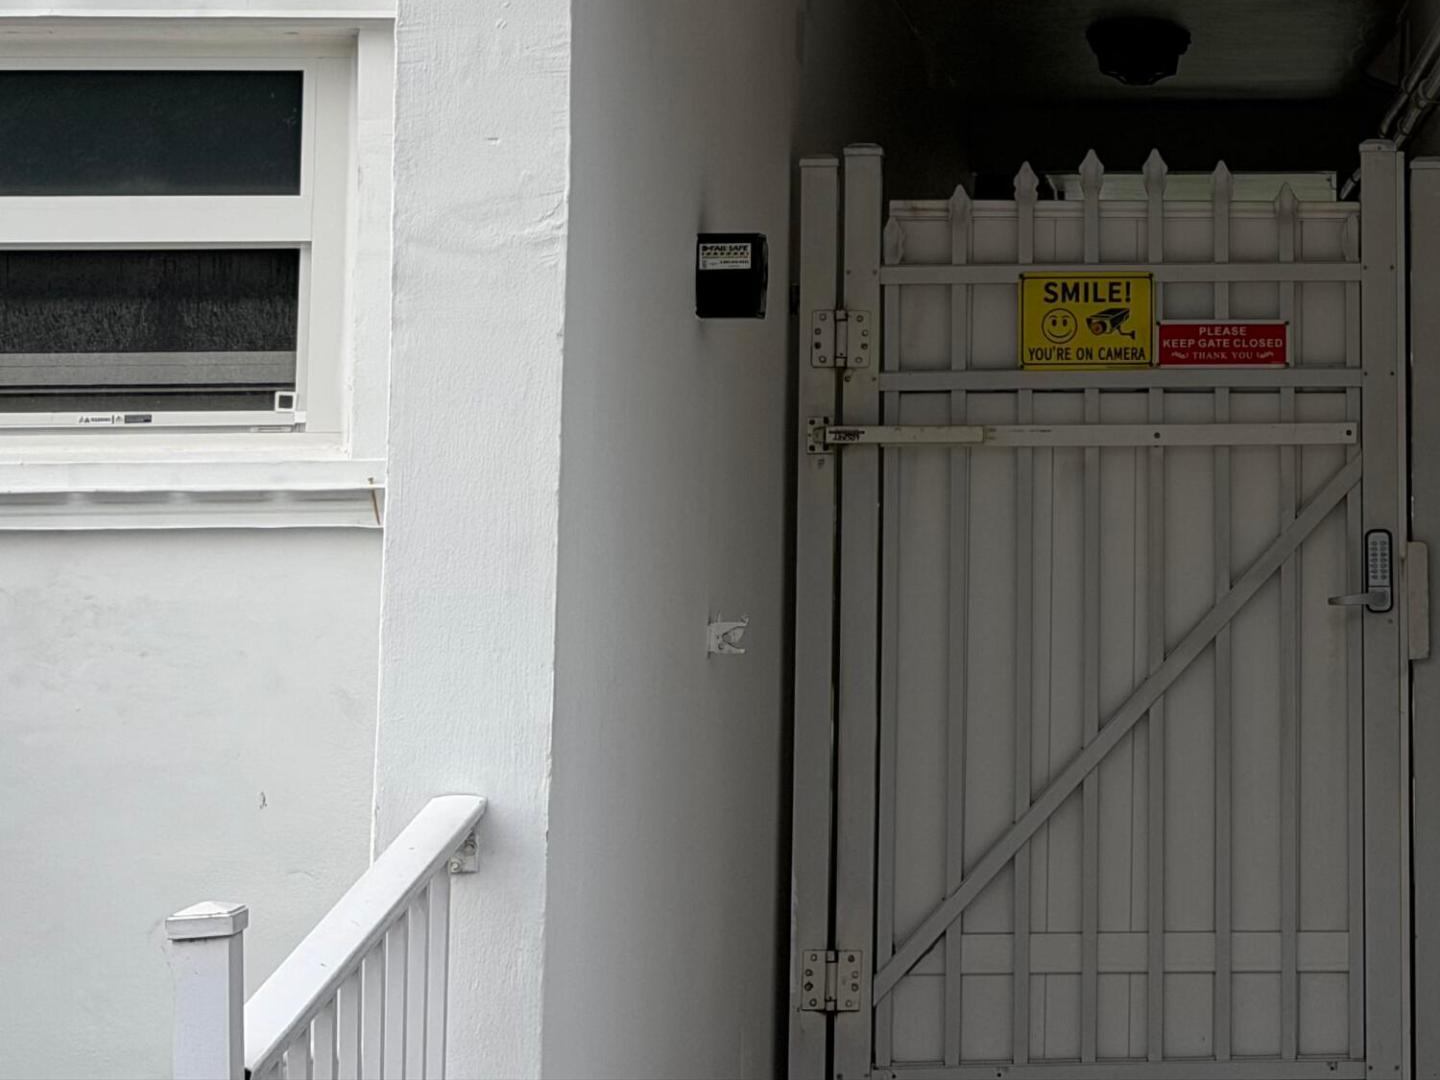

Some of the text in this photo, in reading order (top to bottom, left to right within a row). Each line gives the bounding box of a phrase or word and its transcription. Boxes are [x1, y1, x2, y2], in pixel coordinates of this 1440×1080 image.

[1043, 281, 1131, 303] SMILE!
[1199, 326, 1247, 336] PLEASE
[1163, 338, 1283, 349] KEEP GATE CLOSED
[1028, 347, 1146, 361] YOU'RE ON CAMERA
[1192, 351, 1253, 360] THANK YOU
